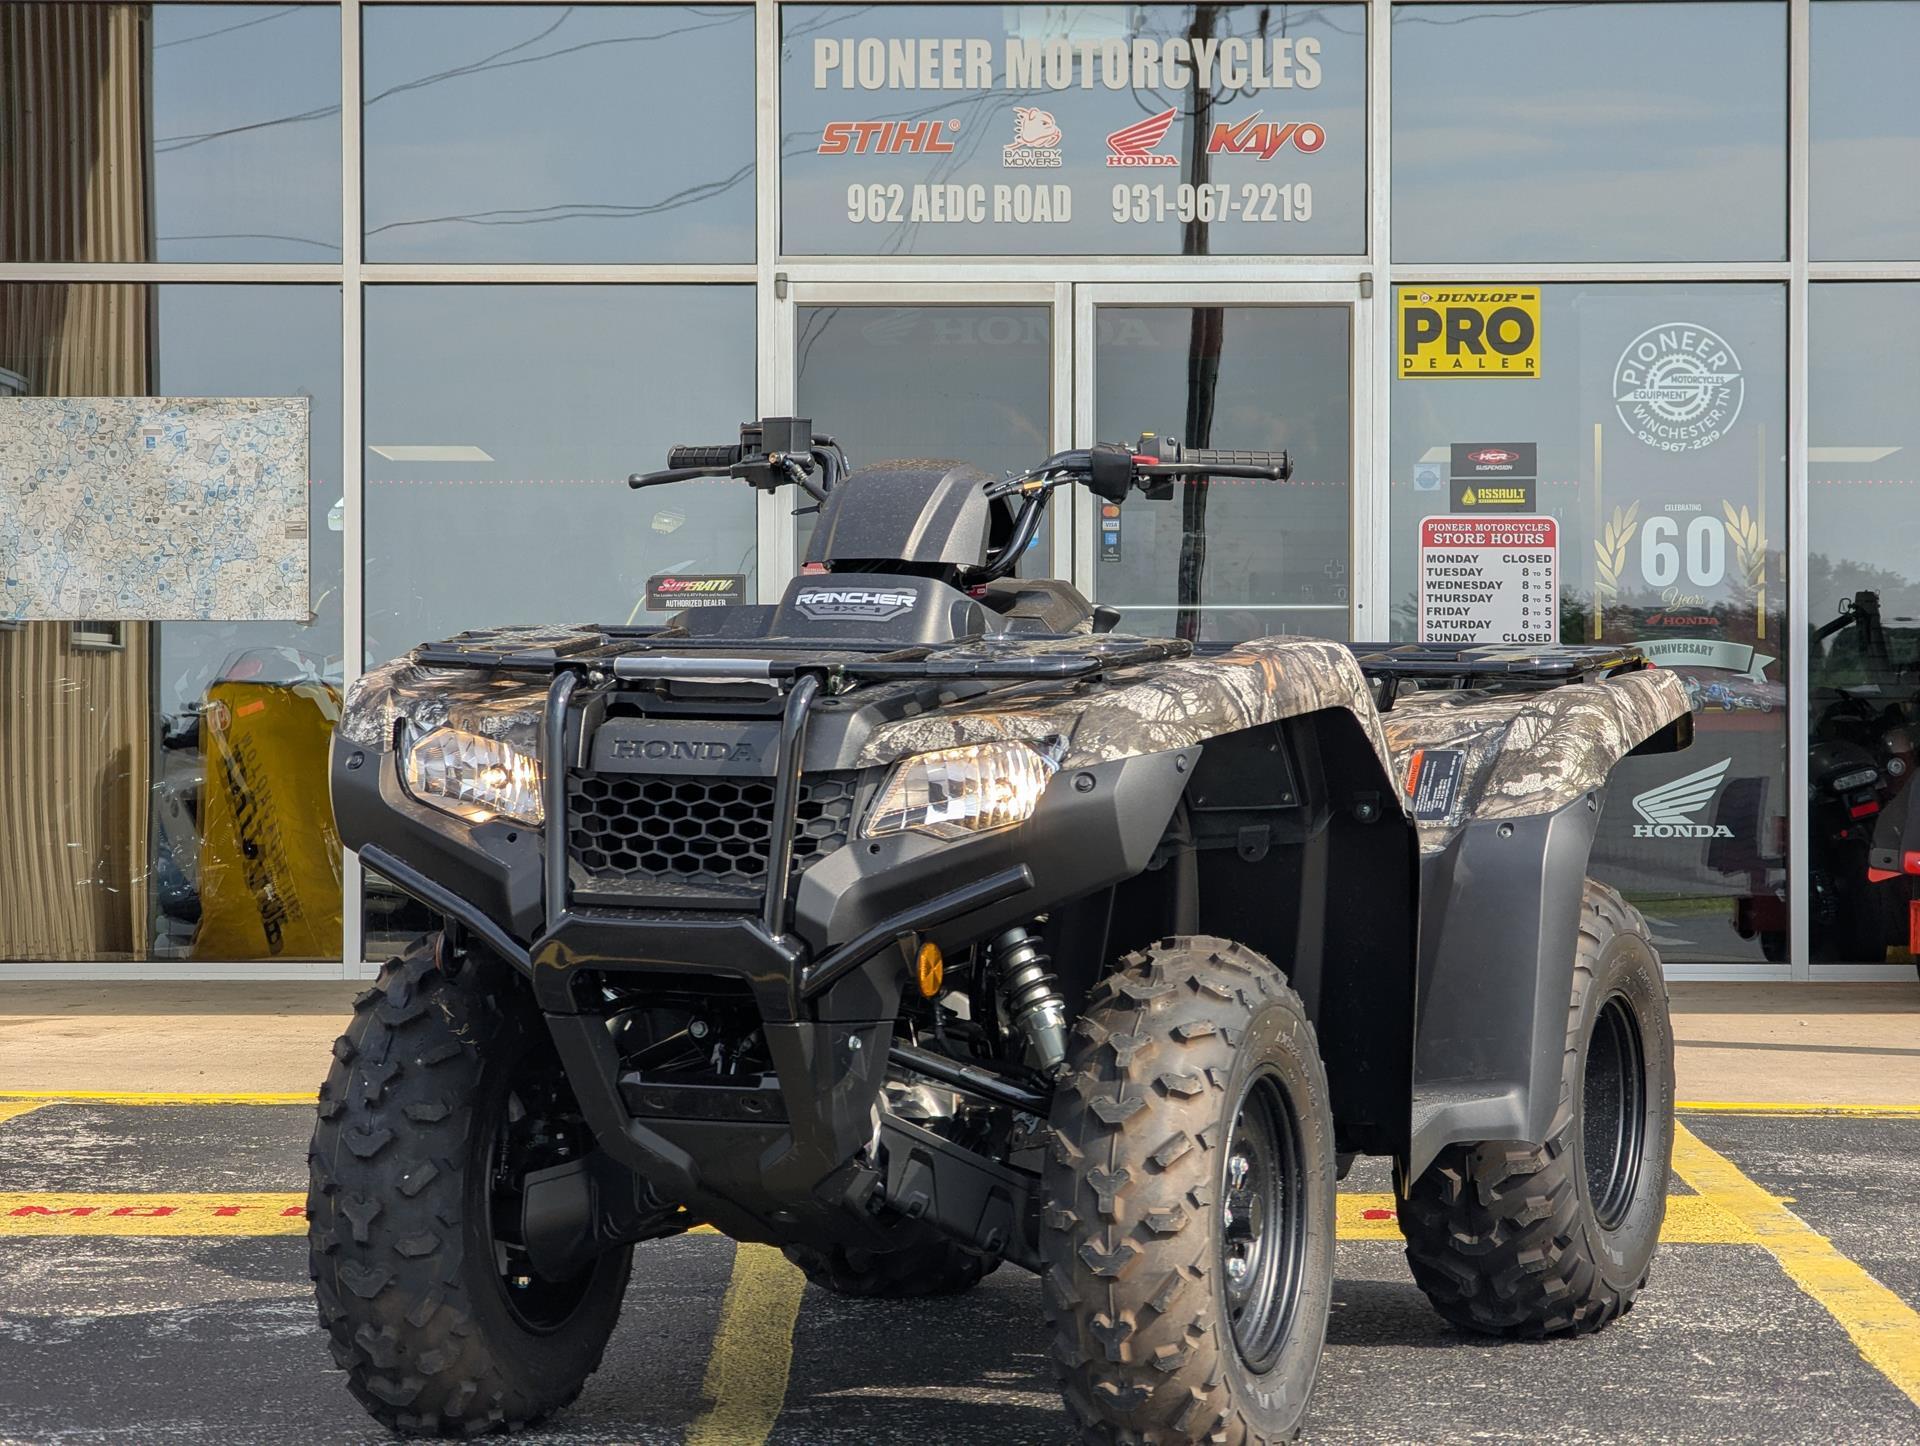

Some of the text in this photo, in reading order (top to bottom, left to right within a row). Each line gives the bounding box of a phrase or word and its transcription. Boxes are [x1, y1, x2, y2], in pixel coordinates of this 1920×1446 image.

[814, 37, 1323, 90] PIONEER MOTORCYCLES
[1207, 110, 1326, 161] KAYO
[1004, 150, 1061, 158] BAD BOY
[1004, 158, 1061, 166] MOWERS
[1107, 155, 1179, 166] HONDA
[847, 184, 1072, 223] 962 AEDC ROAD
[1112, 183, 1313, 223] 931-967-2219
[1435, 293, 1518, 303] DUNLOP
[1404, 306, 1535, 355] PRO
[1622, 330, 1728, 385] PIONEER
[1404, 357, 1535, 369] DEALER
[1671, 376, 1726, 384] MOTORCYCLES
[1633, 390, 1688, 400] EQUIPMENT
[1638, 430, 1720, 452] 931-967-2219
[1477, 489, 1526, 499] ASSAULT
[1664, 504, 1702, 512] CELEBRATING
[1428, 523, 1551, 531] PIONEER MOTORCYCLES
[1433, 533, 1545, 545] STORE HOURS
[1641, 515, 1725, 587] 60
[1426, 554, 1552, 563] MONDAY CLOSED
[1426, 567, 1484, 576] TUESDAY
[1521, 567, 1529, 576] 8
[1544, 567, 1552, 576] 5
[1426, 580, 1503, 589] WEDNESDAY
[1521, 580, 1529, 589] 8
[1544, 580, 1552, 589] 5
[665, 599, 727, 608] AUTHORIZED DEALER
[795, 592, 917, 608] RANCHER
[1426, 594, 1494, 603] THURSDAY
[1521, 594, 1529, 603] 8
[1544, 594, 1552, 603] 5
[1660, 586, 1705, 613] Years
[1426, 607, 1471, 616] FRIDAY
[1521, 607, 1529, 616] 8
[1544, 607, 1552, 616] 5
[1426, 620, 1492, 629] SATURDAY
[1521, 620, 1529, 629] 8
[1544, 620, 1552, 629] 3
[1663, 616, 1720, 625] HONDA
[1426, 633, 1552, 642] SUNDAY CLOSED
[1648, 643, 1715, 657] ANNIVERSARY
[610, 739, 762, 762] HONDA
[1632, 824, 1735, 838] HONDA
